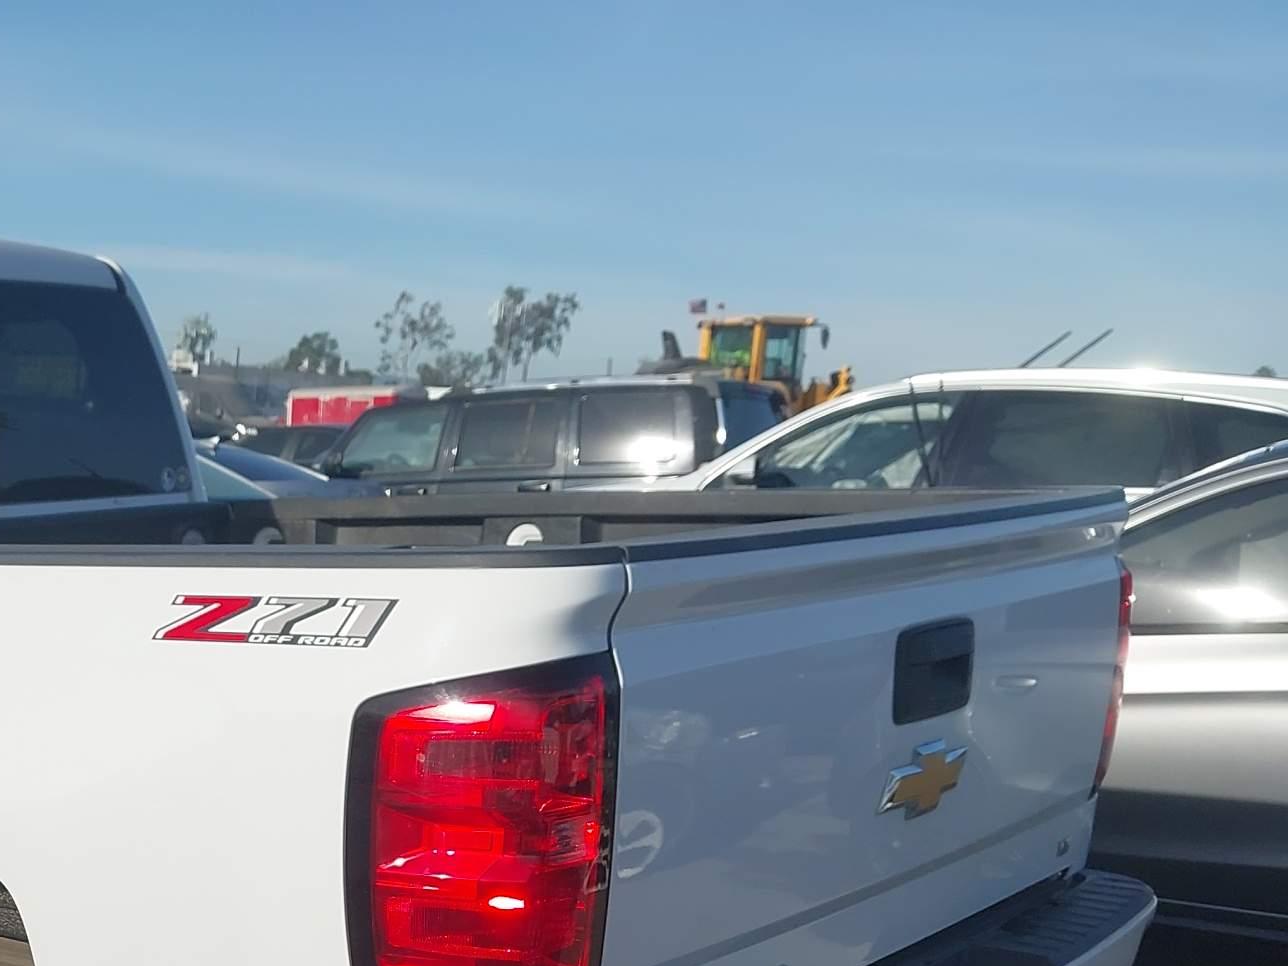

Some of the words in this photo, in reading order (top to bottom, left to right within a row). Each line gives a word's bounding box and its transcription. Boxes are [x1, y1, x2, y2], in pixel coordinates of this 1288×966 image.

[152, 595, 400, 648] Z71
[248, 634, 293, 645] OFF
[297, 635, 367, 648] ROAD
